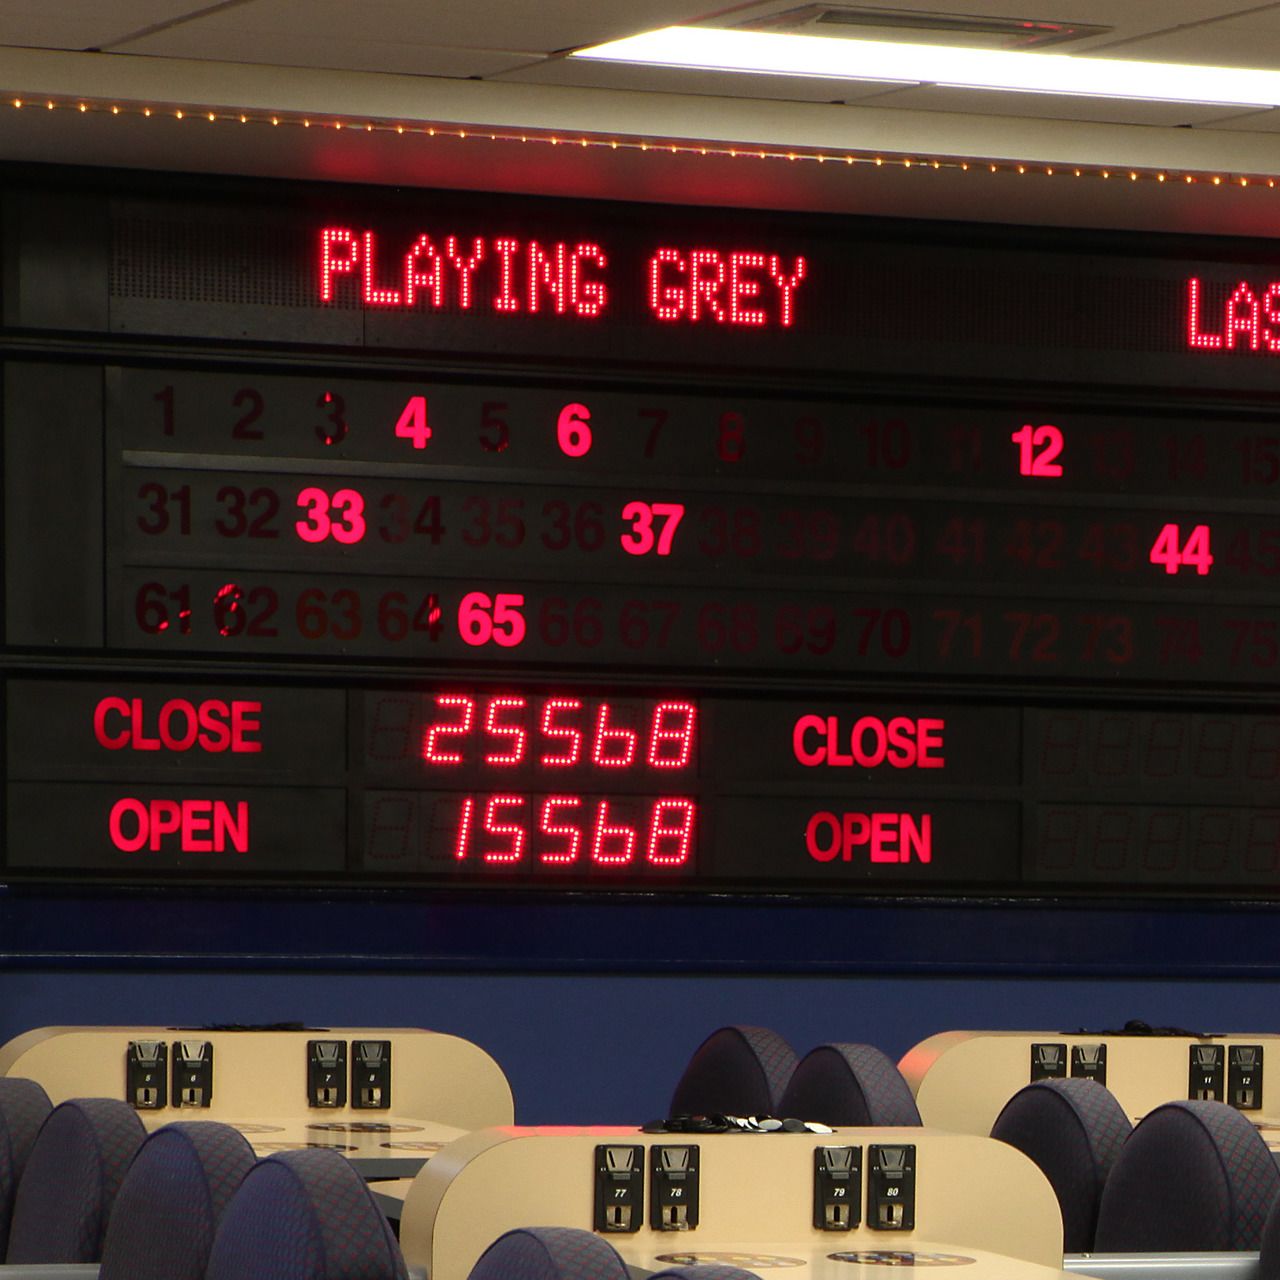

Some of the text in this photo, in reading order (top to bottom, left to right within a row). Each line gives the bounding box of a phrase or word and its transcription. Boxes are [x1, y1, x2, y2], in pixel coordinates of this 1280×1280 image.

[320, 228, 807, 328] PLAYING GREY
[154, 386, 175, 436] 1
[232, 389, 264, 439] 2
[314, 392, 347, 445] 3
[395, 396, 431, 449] 4
[479, 403, 509, 452] 5
[557, 403, 592, 457] 6
[638, 410, 669, 458] 7
[716, 412, 745, 462] 8
[1012, 425, 1064, 477] 12
[138, 483, 192, 536] 31
[216, 488, 280, 539] 32
[296, 489, 366, 544] 33
[378, 494, 445, 544] 34
[461, 497, 526, 547] 35
[541, 500, 604, 550] 36
[621, 502, 684, 555] 37
[1151, 523, 1212, 575] 44
[136, 582, 192, 634] 61
[214, 584, 279, 638] 62
[296, 591, 361, 639] 63
[377, 592, 442, 641] 64
[459, 593, 526, 646] 65
[775, 606, 836, 654] 69
[855, 608, 911, 656] 70
[93, 696, 262, 753] CLOSE
[423, 696, 695, 768] 25568
[793, 715, 944, 770] CLOSE
[108, 798, 249, 854] OPEN
[455, 796, 696, 865] 15568
[805, 813, 932, 865] OPEN
[1204, 1076, 1212, 1084] 11
[614, 1188, 627, 1198] 77
[671, 1188, 682, 1197] 78
[833, 1188, 845, 1197] 79
[887, 1187, 899, 1197] 80
